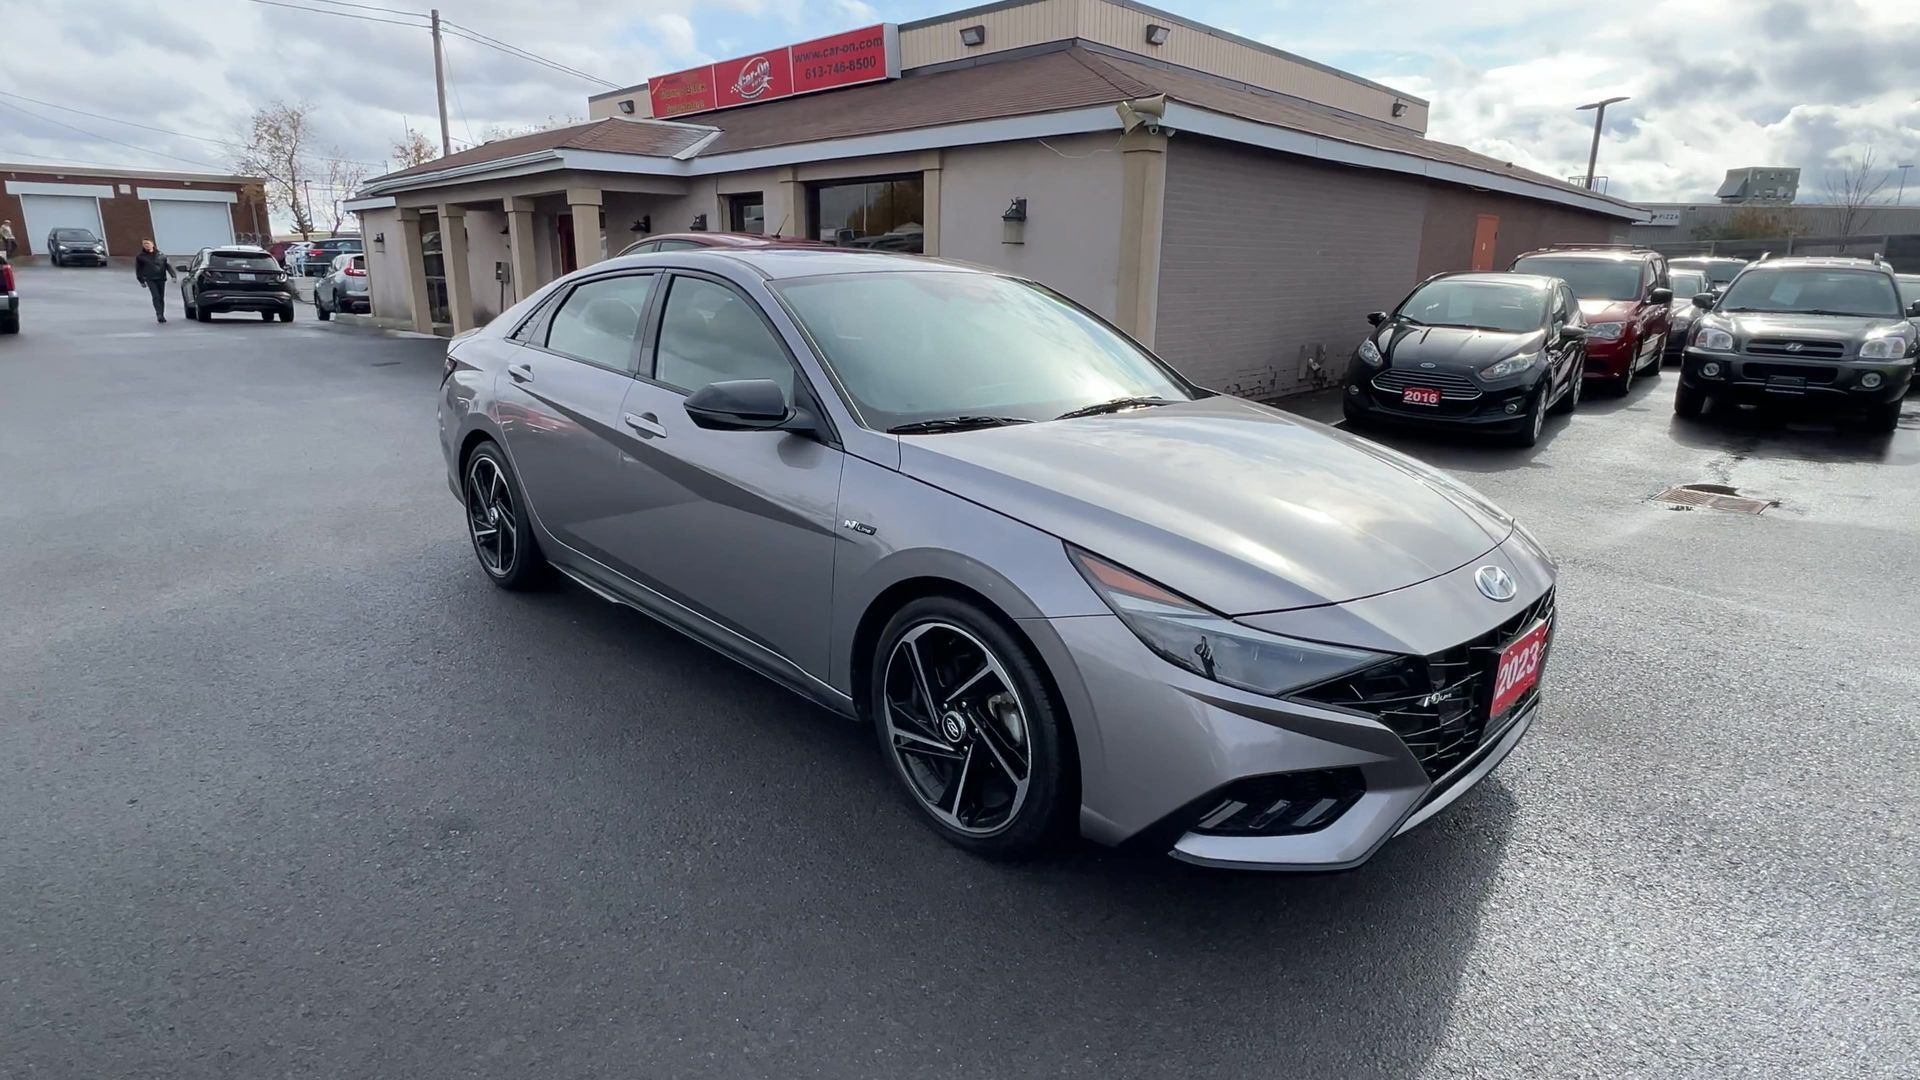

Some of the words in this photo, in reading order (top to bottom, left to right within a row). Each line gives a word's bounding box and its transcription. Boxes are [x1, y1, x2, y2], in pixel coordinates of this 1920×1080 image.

[794, 37, 884, 62] www.car-on.com
[805, 56, 877, 80] 613-746-8500
[1403, 390, 1438, 404] 2016
[1496, 641, 1539, 699] 2023
